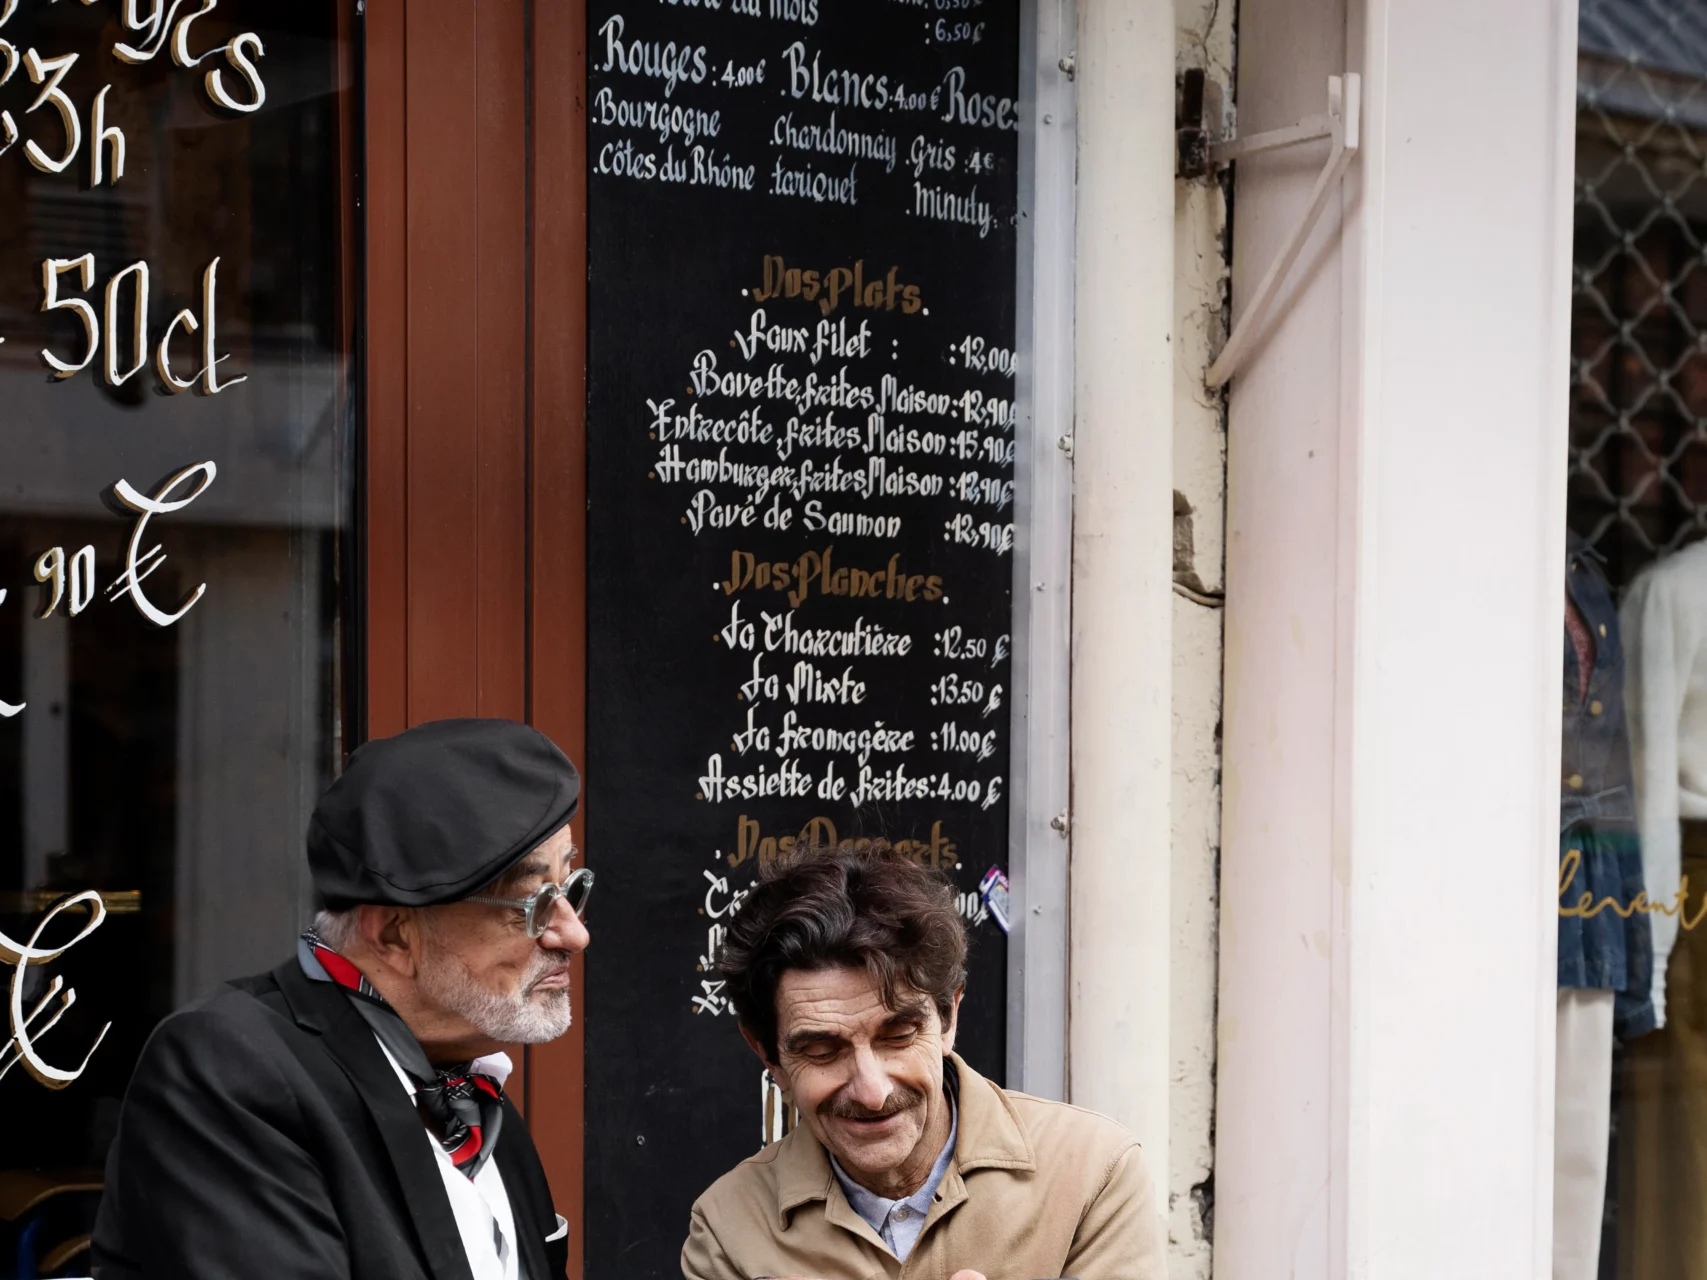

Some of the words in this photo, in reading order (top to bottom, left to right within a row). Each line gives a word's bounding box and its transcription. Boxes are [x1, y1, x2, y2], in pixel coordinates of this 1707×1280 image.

[598, 14, 707, 99] Rouges
[782, 41, 888, 110] Blancs
[595, 86, 721, 147] Bourgogne
[774, 110, 896, 174] Chardonnay
[911, 134, 956, 179] Gris
[600, 138, 657, 180] Côtes
[660, 144, 687, 183] du
[690, 144, 755, 191] Rhône
[819, 259, 922, 317] Plats
[809, 316, 871, 366] filet
[686, 488, 758, 536] Pavé
[764, 493, 793, 531] de
[803, 500, 901, 539] Saumon
[787, 544, 944, 608] Planches
[721, 599, 755, 651] La
[760, 610, 914, 656] Charcutière
[739, 651, 779, 701] La
[785, 660, 868, 705] Mixte
[733, 701, 770, 757] La
[699, 753, 813, 804] Assiette
[817, 760, 847, 801] de
